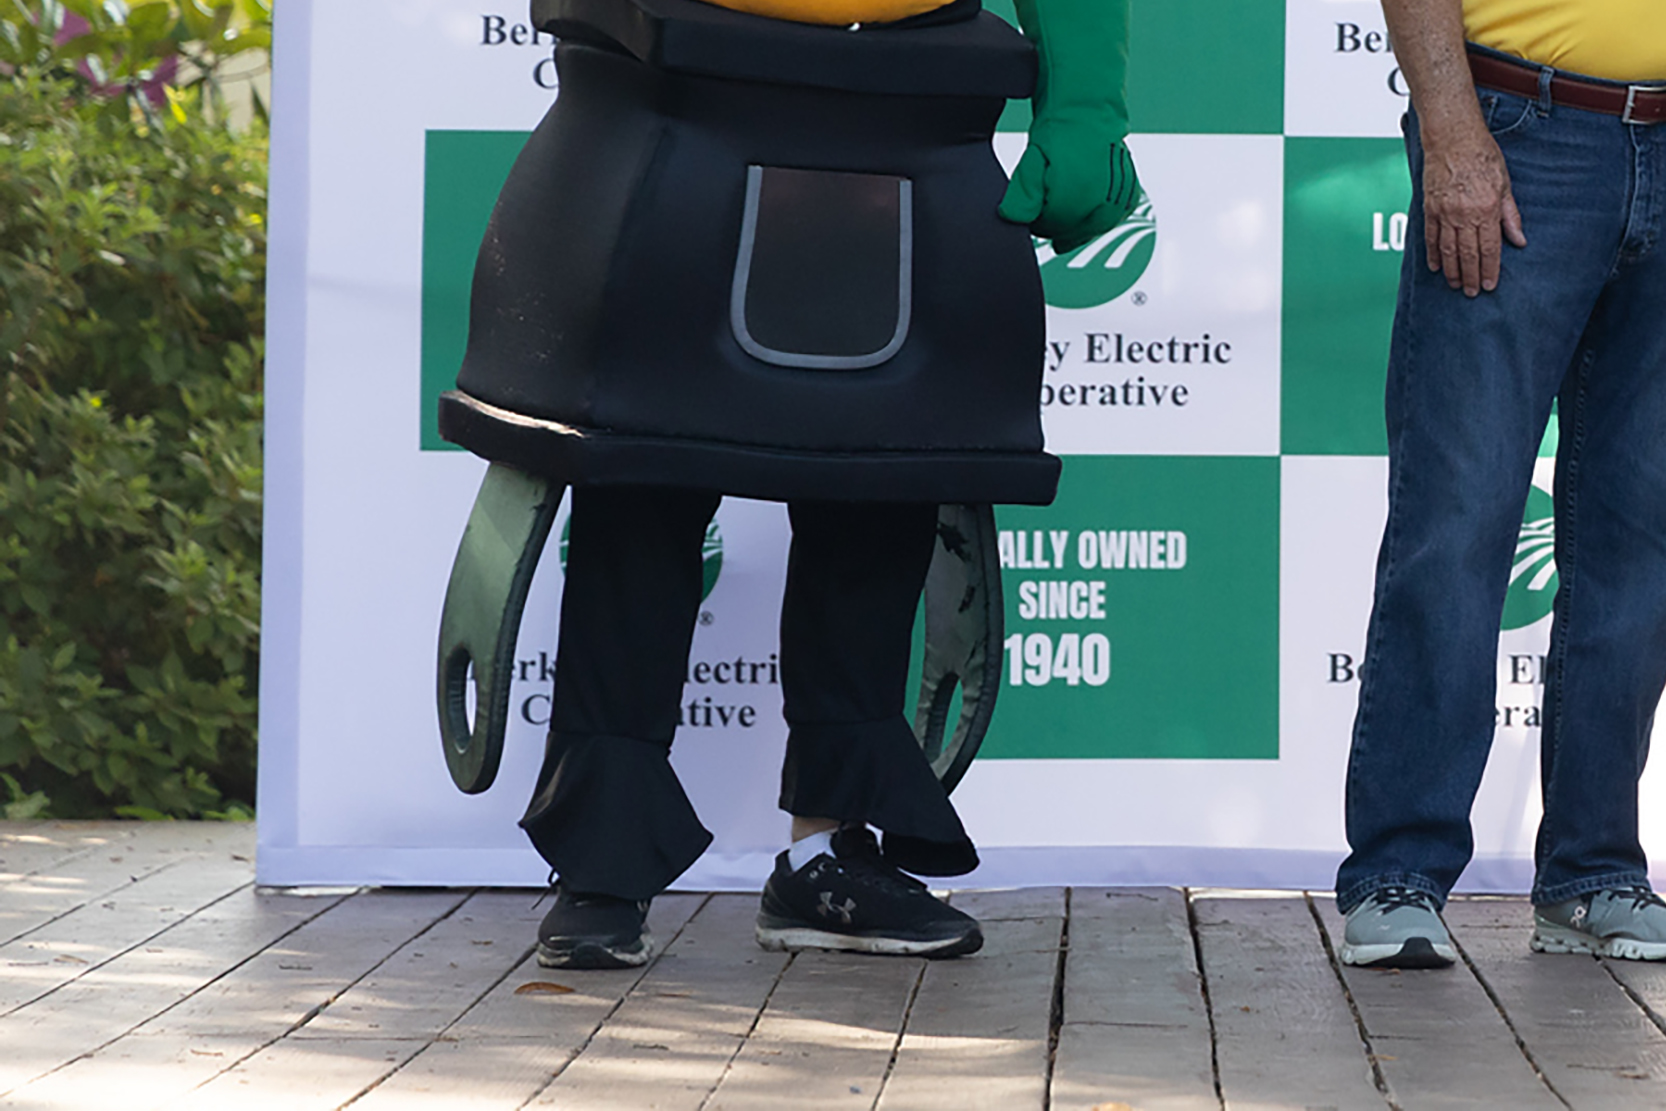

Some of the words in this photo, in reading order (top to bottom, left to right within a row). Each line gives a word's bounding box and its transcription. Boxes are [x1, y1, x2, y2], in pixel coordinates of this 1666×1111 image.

[1083, 333, 1232, 365] Electric
[998, 530, 1069, 569] ALLY
[1077, 530, 1188, 570] OWNED
[1018, 580, 1106, 620] SINCE
[1003, 633, 1111, 686] 1940
